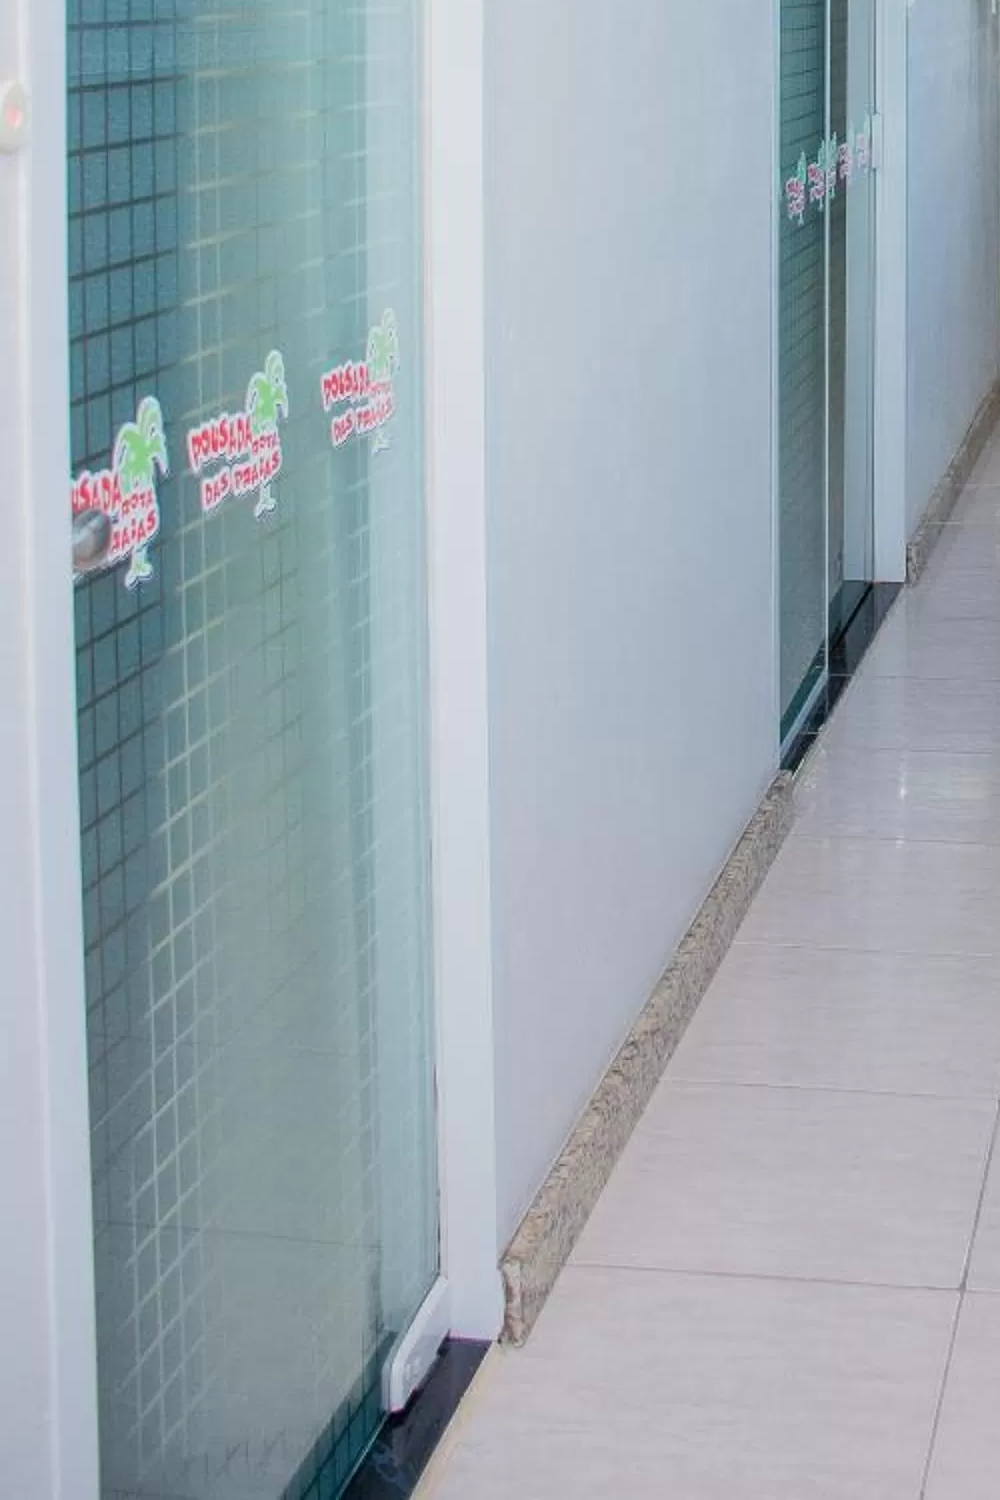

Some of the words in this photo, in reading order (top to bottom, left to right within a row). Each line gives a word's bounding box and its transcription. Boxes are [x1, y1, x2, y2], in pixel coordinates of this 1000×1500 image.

[191, 414, 253, 467] POUSADA
[71, 474, 121, 515] USADA
[204, 471, 229, 507] DAS
